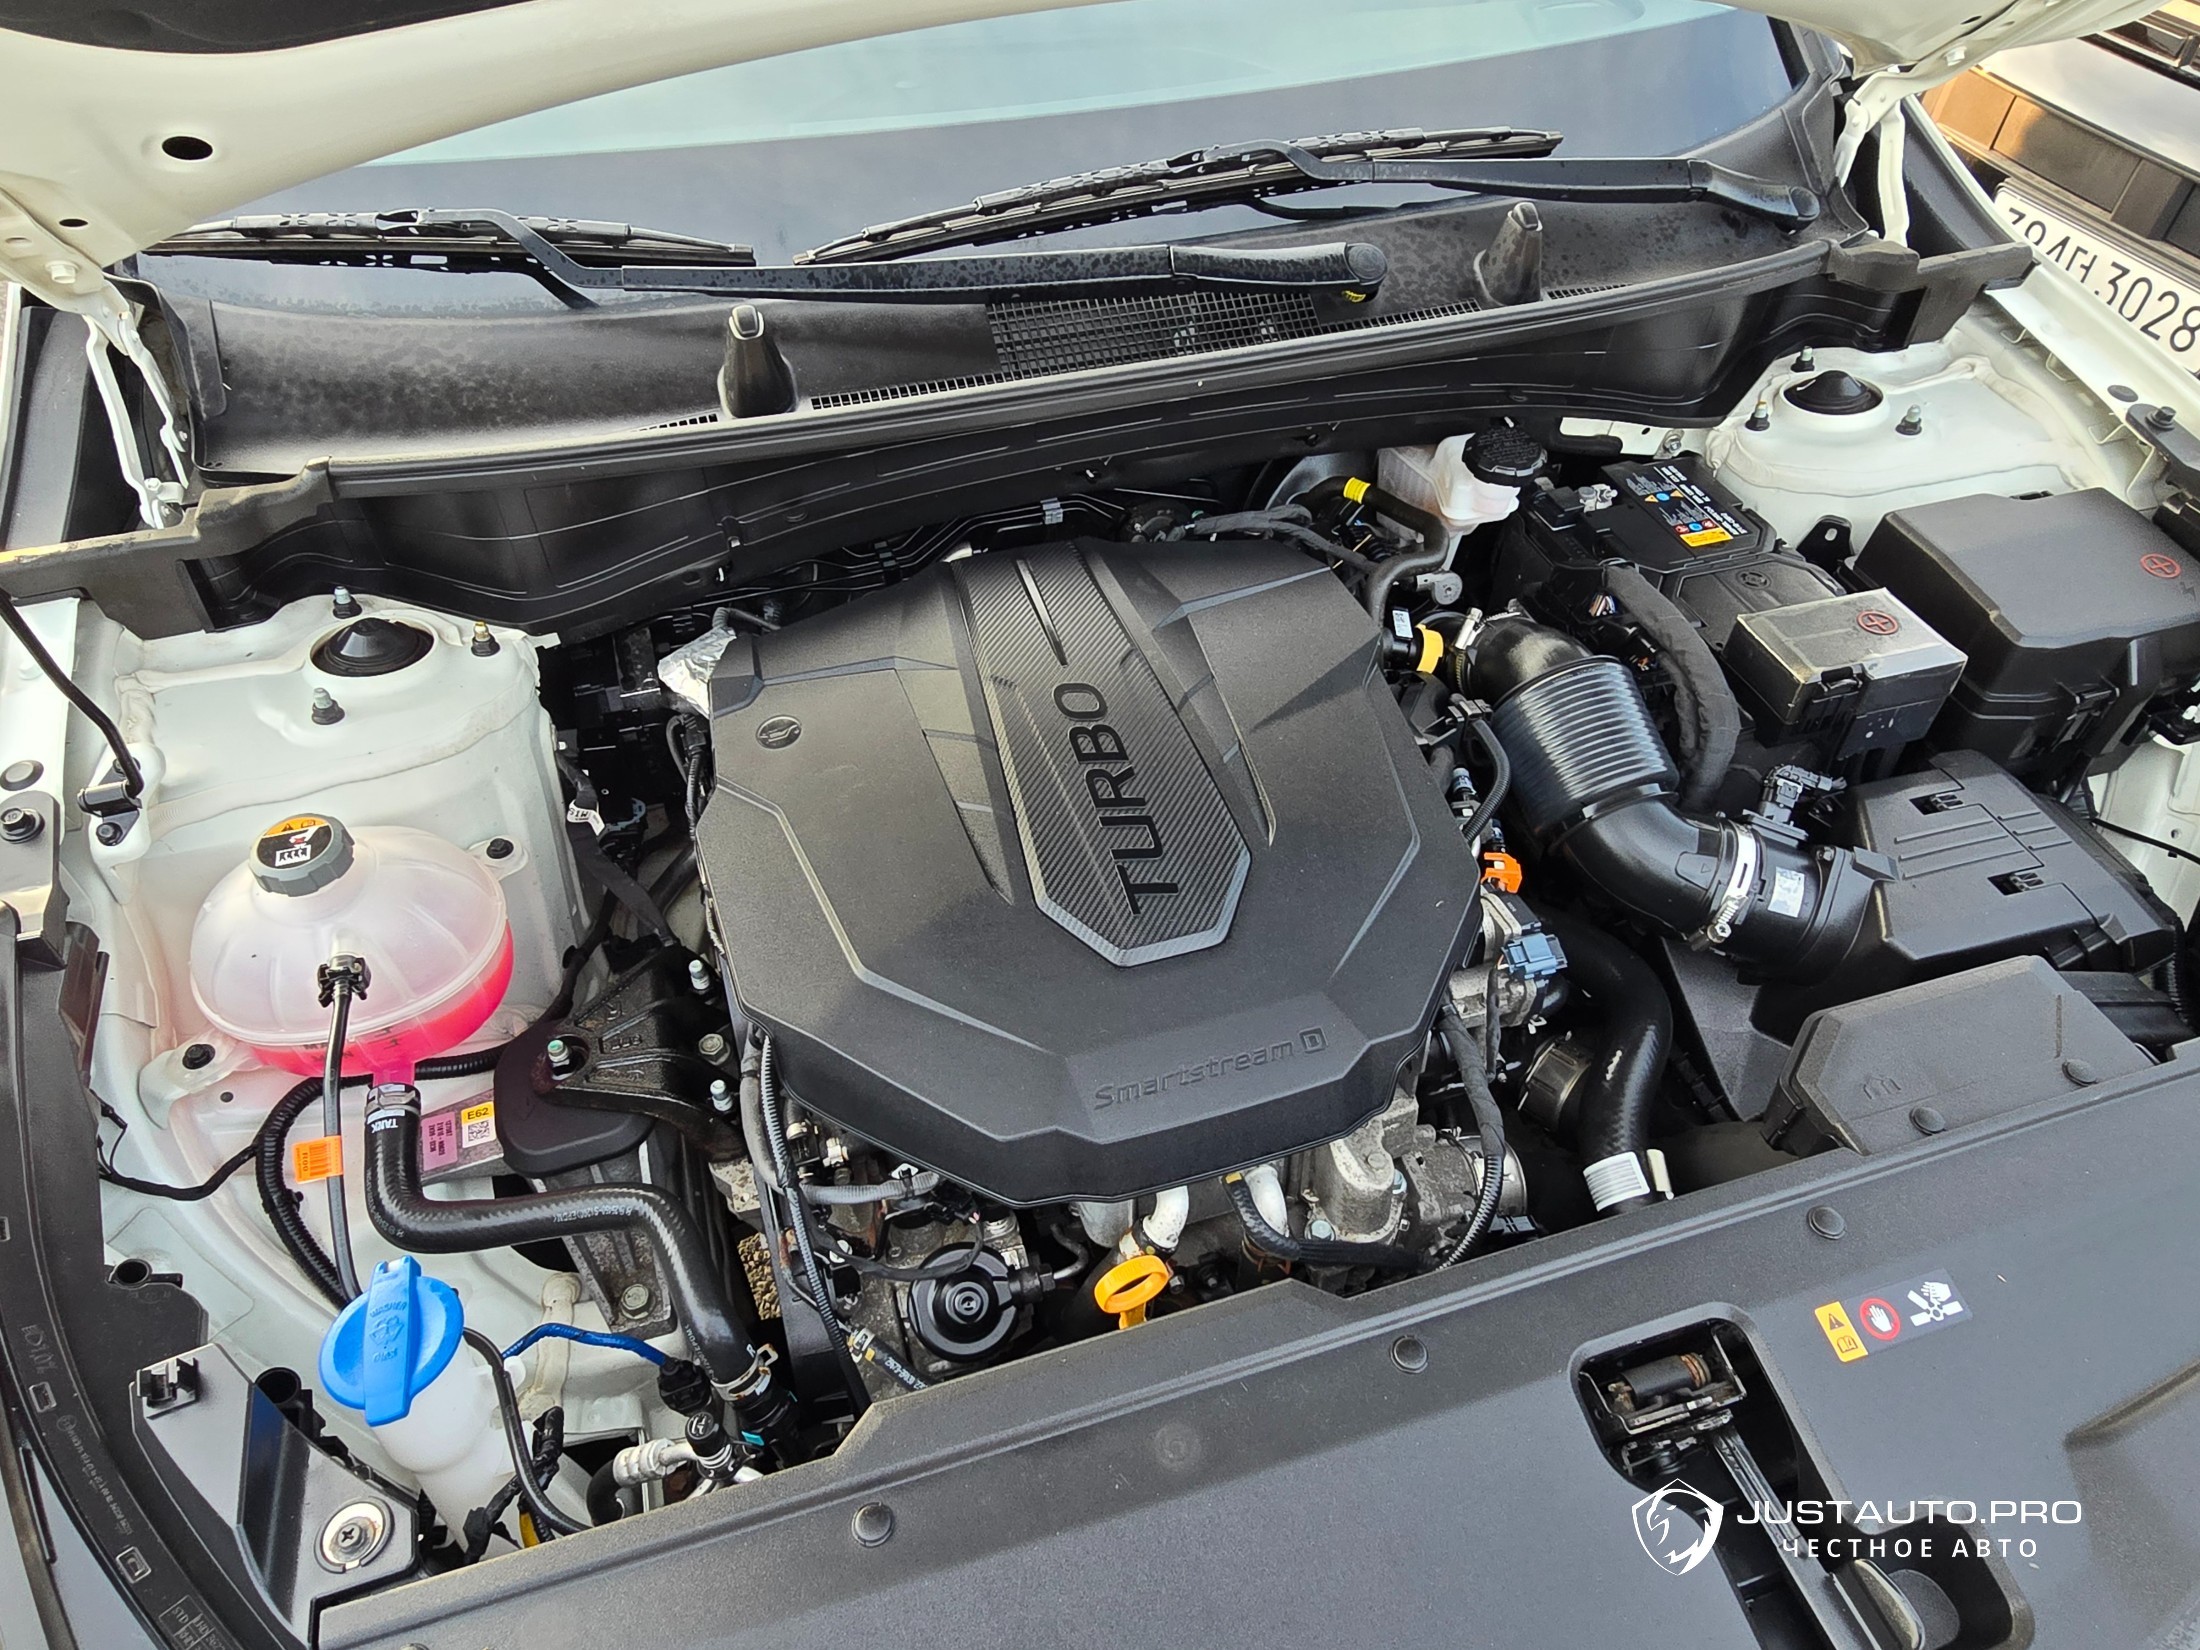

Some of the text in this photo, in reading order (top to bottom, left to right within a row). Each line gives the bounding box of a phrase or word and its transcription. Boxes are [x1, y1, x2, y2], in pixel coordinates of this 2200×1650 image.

[2094, 260, 2200, 353] 3028
[1052, 682, 1180, 916] TURBO
[1094, 1028, 1327, 1110] Smartstream D
[467, 1107, 490, 1120] E62
